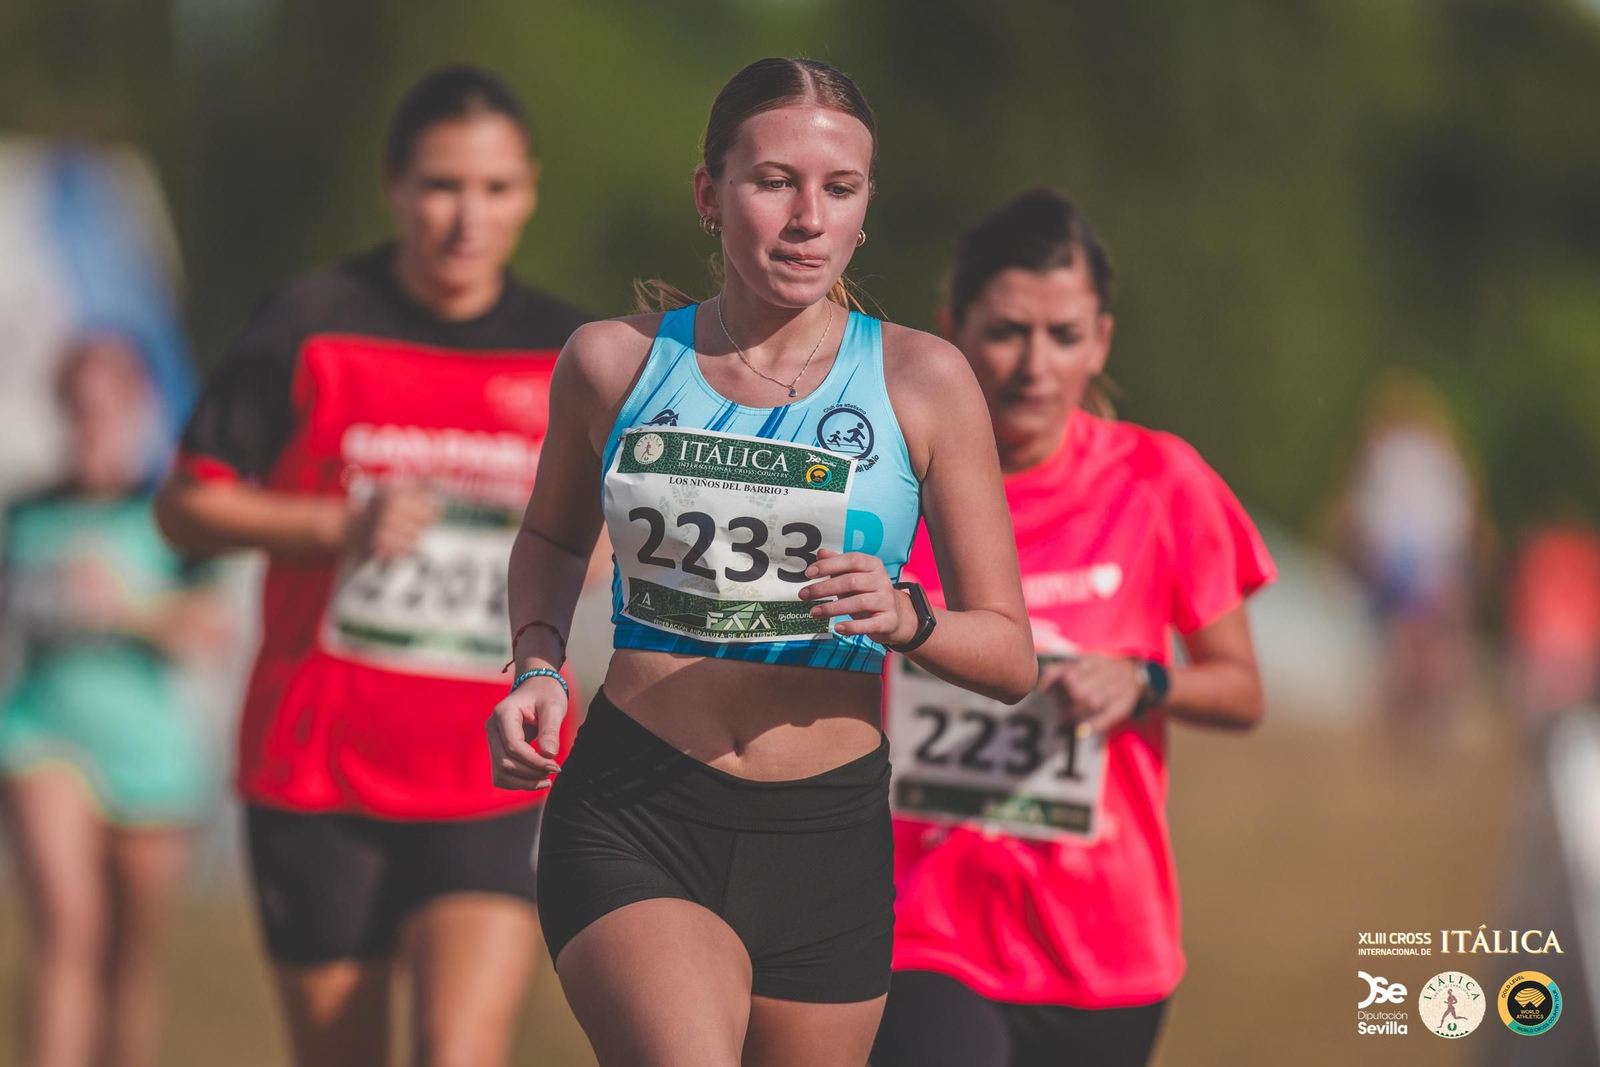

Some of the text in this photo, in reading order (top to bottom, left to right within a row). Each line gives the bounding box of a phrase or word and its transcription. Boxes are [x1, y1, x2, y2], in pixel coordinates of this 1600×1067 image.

[823, 405, 835, 413] Club
[844, 403, 866, 414] atletismo
[679, 439, 789, 472] ITÁLICA
[678, 461, 789, 478] INTERNATIONAL CROSS COUNTRY
[669, 476, 688, 486] LOS
[690, 478, 720, 489] NIÑOS
[722, 482, 741, 491] DEL
[744, 485, 782, 495] BARRIO
[628, 506, 822, 583] 2233
[690, 628, 728, 639] ANDALUZA
[740, 631, 777, 639] ATLETISMO
[914, 704, 1084, 782] 2231
